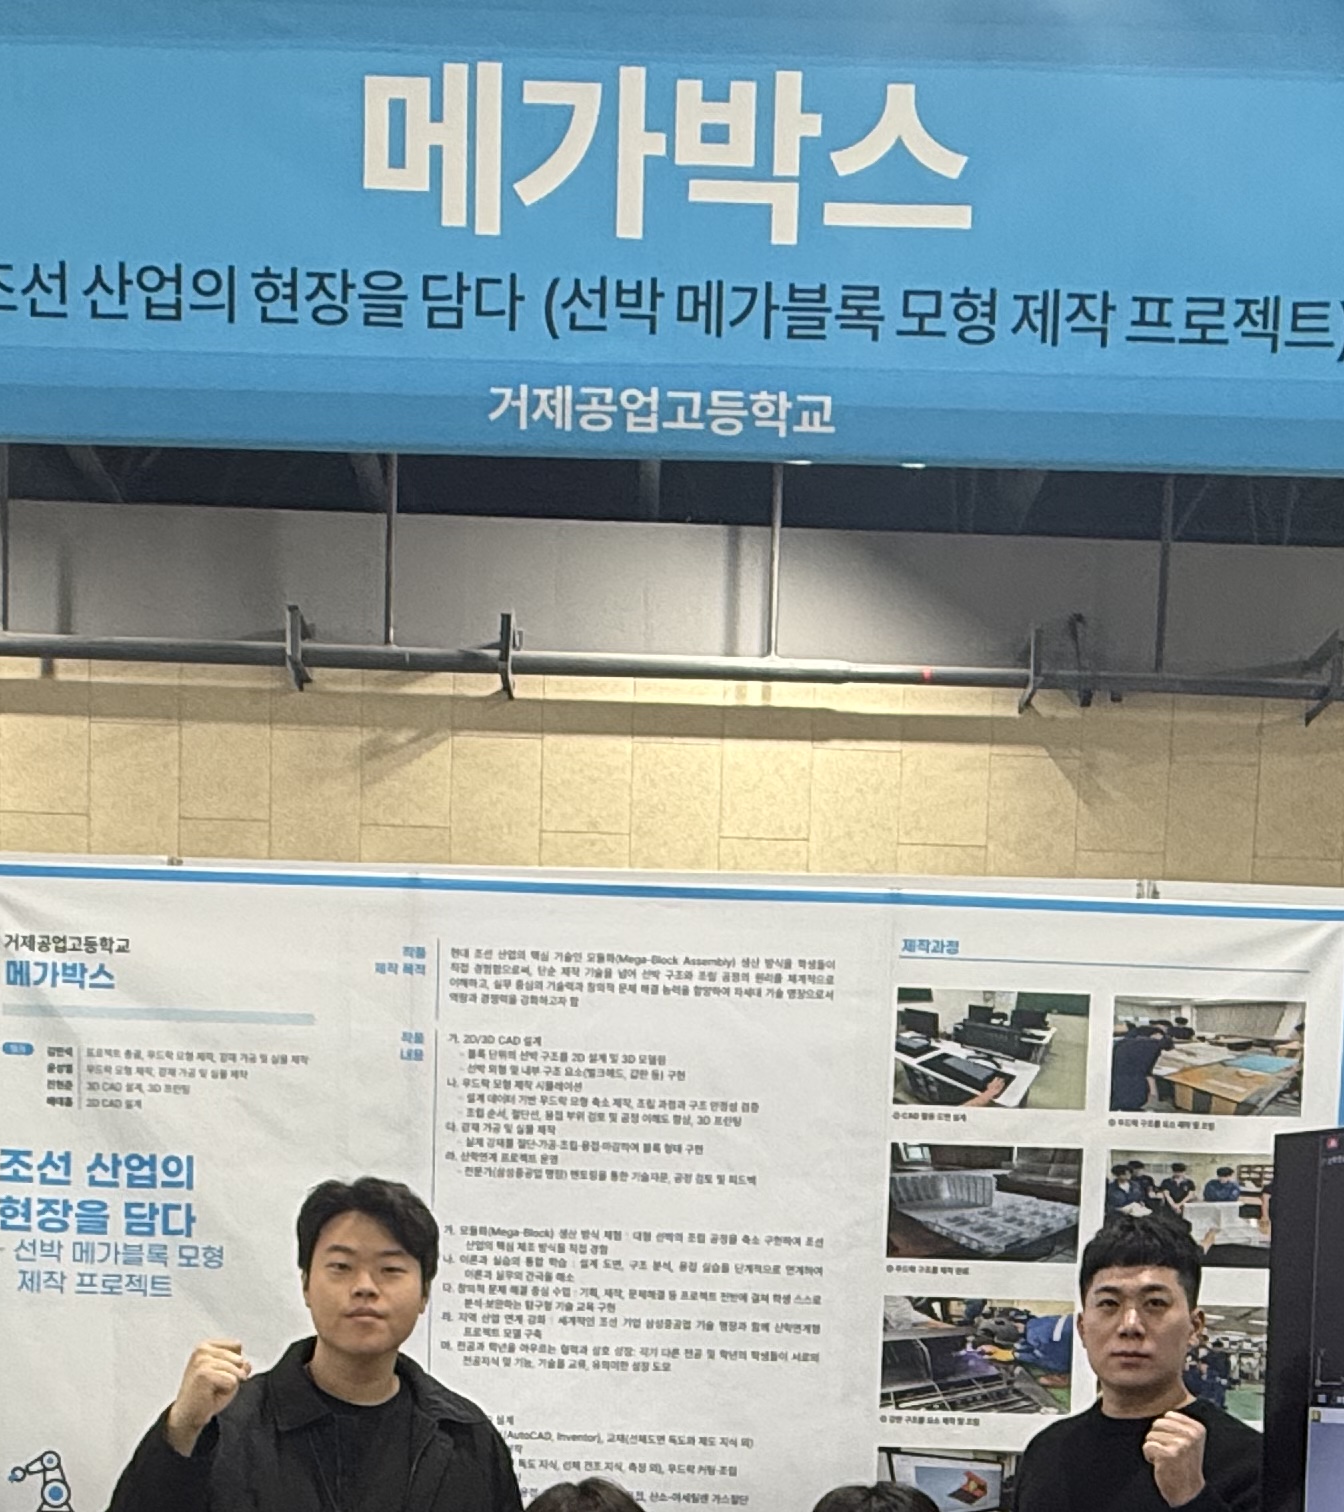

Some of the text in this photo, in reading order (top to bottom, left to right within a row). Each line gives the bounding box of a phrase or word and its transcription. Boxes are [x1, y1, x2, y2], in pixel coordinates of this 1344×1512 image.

[362, 60, 972, 245] 메가박스
[83, 262, 237, 324] 산업의
[251, 266, 408, 328] 현장을
[423, 270, 525, 332] 담다
[544, 274, 665, 339] (선박
[676, 279, 886, 342] 메가블록
[895, 287, 999, 346] 모형
[1012, 288, 1115, 349] 제작
[487, 382, 835, 438] 거제공업고등학교
[5, 934, 131, 954] 거제공업고등학교
[6, 961, 115, 990] 메가박스
[87, 1153, 194, 1190] 산업의
[124, 1201, 197, 1238] 담다
[13, 1239, 224, 1270] 선박 메가블록 모형
[17, 1269, 173, 1298] 제작 프로젝트
